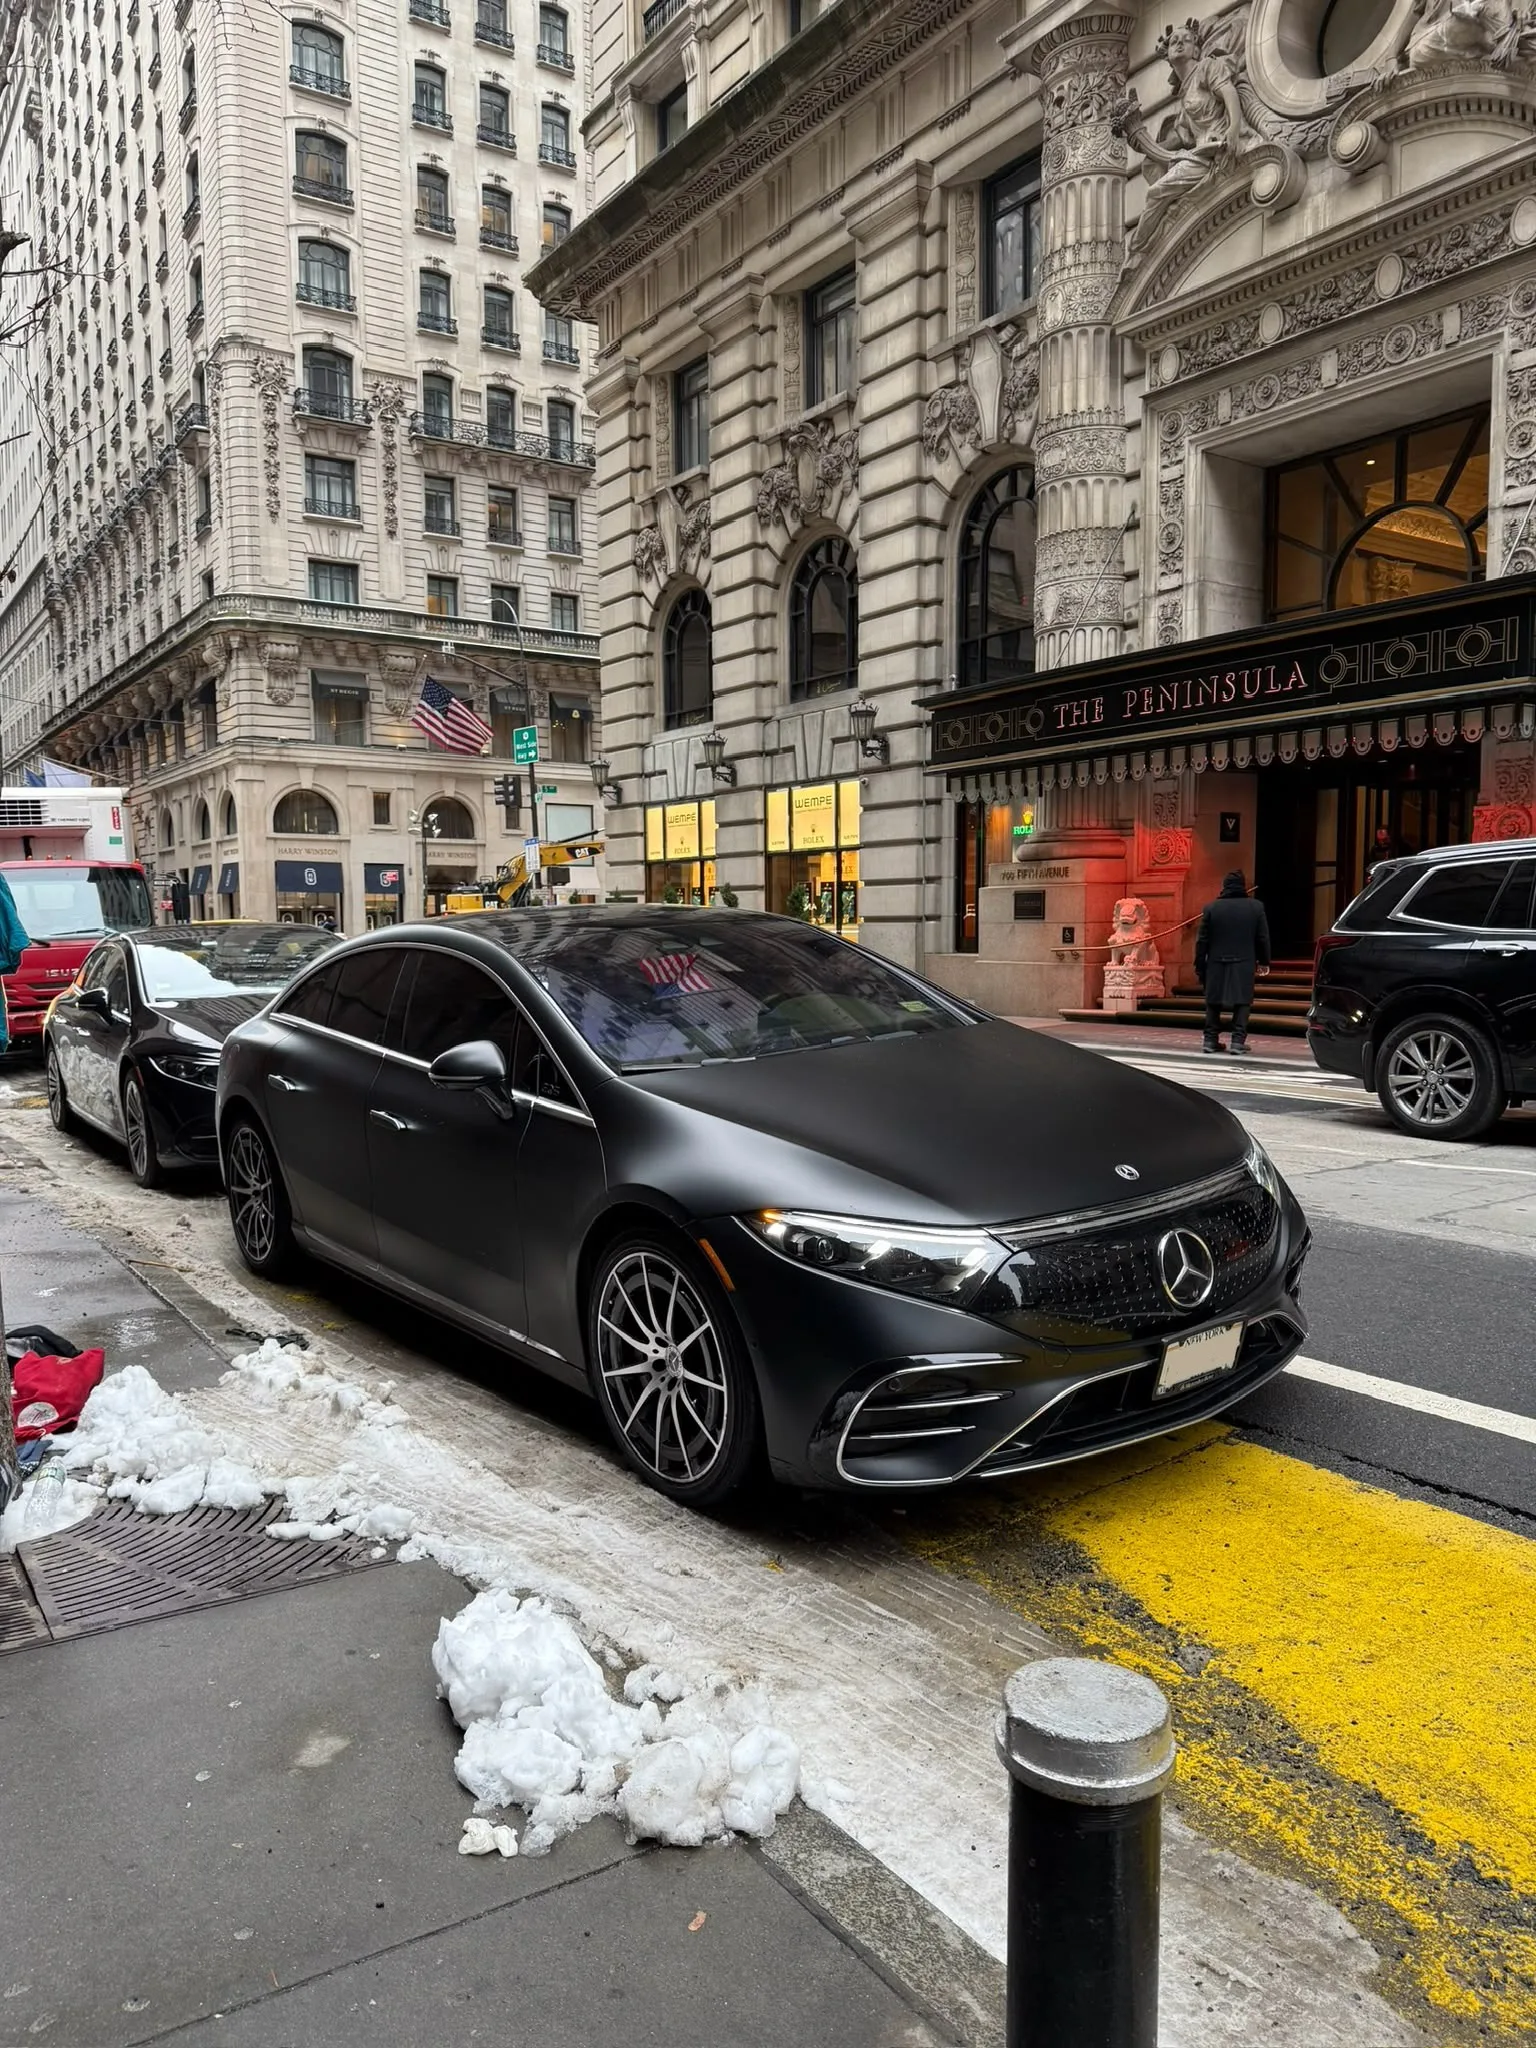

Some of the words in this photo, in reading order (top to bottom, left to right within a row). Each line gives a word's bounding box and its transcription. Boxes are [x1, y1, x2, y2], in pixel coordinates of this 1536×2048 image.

[1053, 697, 1104, 729] THE
[1122, 660, 1308, 718] PENINSULA
[795, 795, 833, 809] WEMPE
[667, 812, 697, 824] WEMPE
[802, 836, 825, 845] ROLEX
[277, 847, 303, 855] HARRY
[304, 847, 339, 856] WINSTON
[574, 847, 589, 858] CAT
[1017, 867, 1038, 880] FIFTH
[1039, 866, 1070, 879] AVENUE
[484, 900, 499, 910] CAT
[45, 967, 80, 978] ISUZ
[1184, 1334, 1203, 1347] NEW
[1204, 1327, 1225, 1341] YORK
